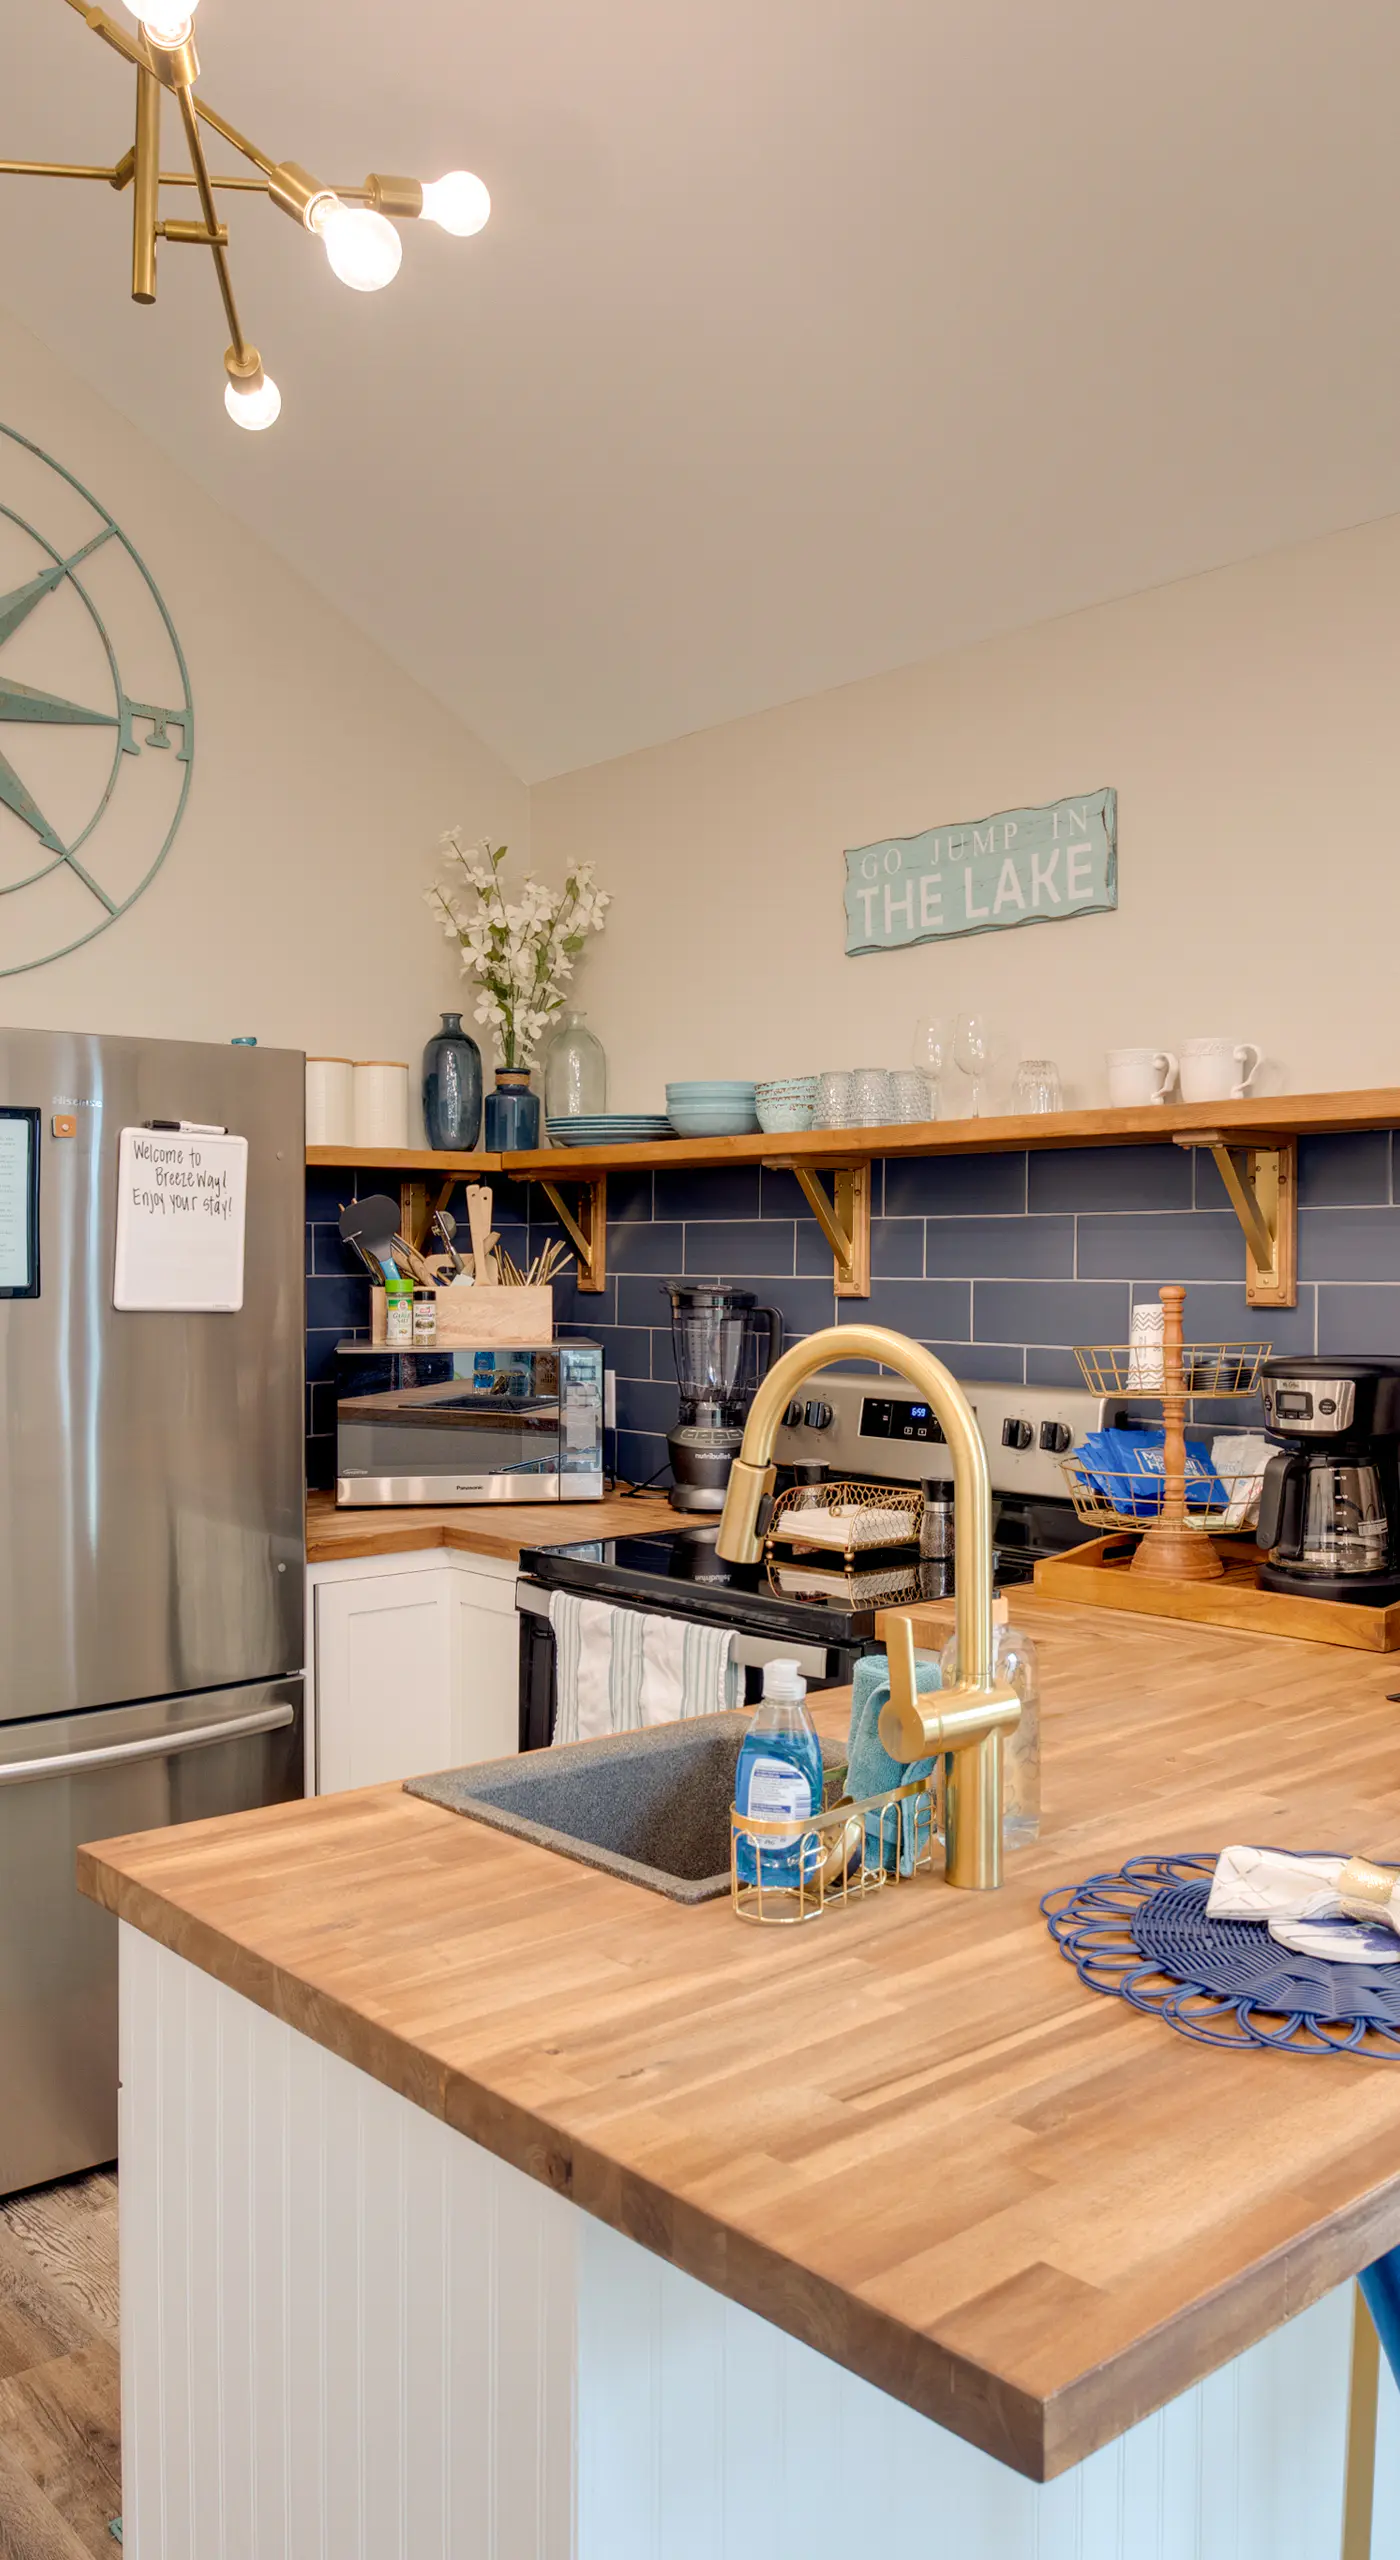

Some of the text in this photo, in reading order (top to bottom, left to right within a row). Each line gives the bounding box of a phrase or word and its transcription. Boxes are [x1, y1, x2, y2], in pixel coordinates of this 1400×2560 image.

[120, 694, 195, 761] E
[860, 804, 1090, 880] GO JUMP IN
[856, 842, 1094, 938] THE LAKE
[133, 1140, 202, 1168] Welcome to
[132, 1187, 232, 1221] Enjoy your stay!
[911, 1407, 926, 1417] 6:59
